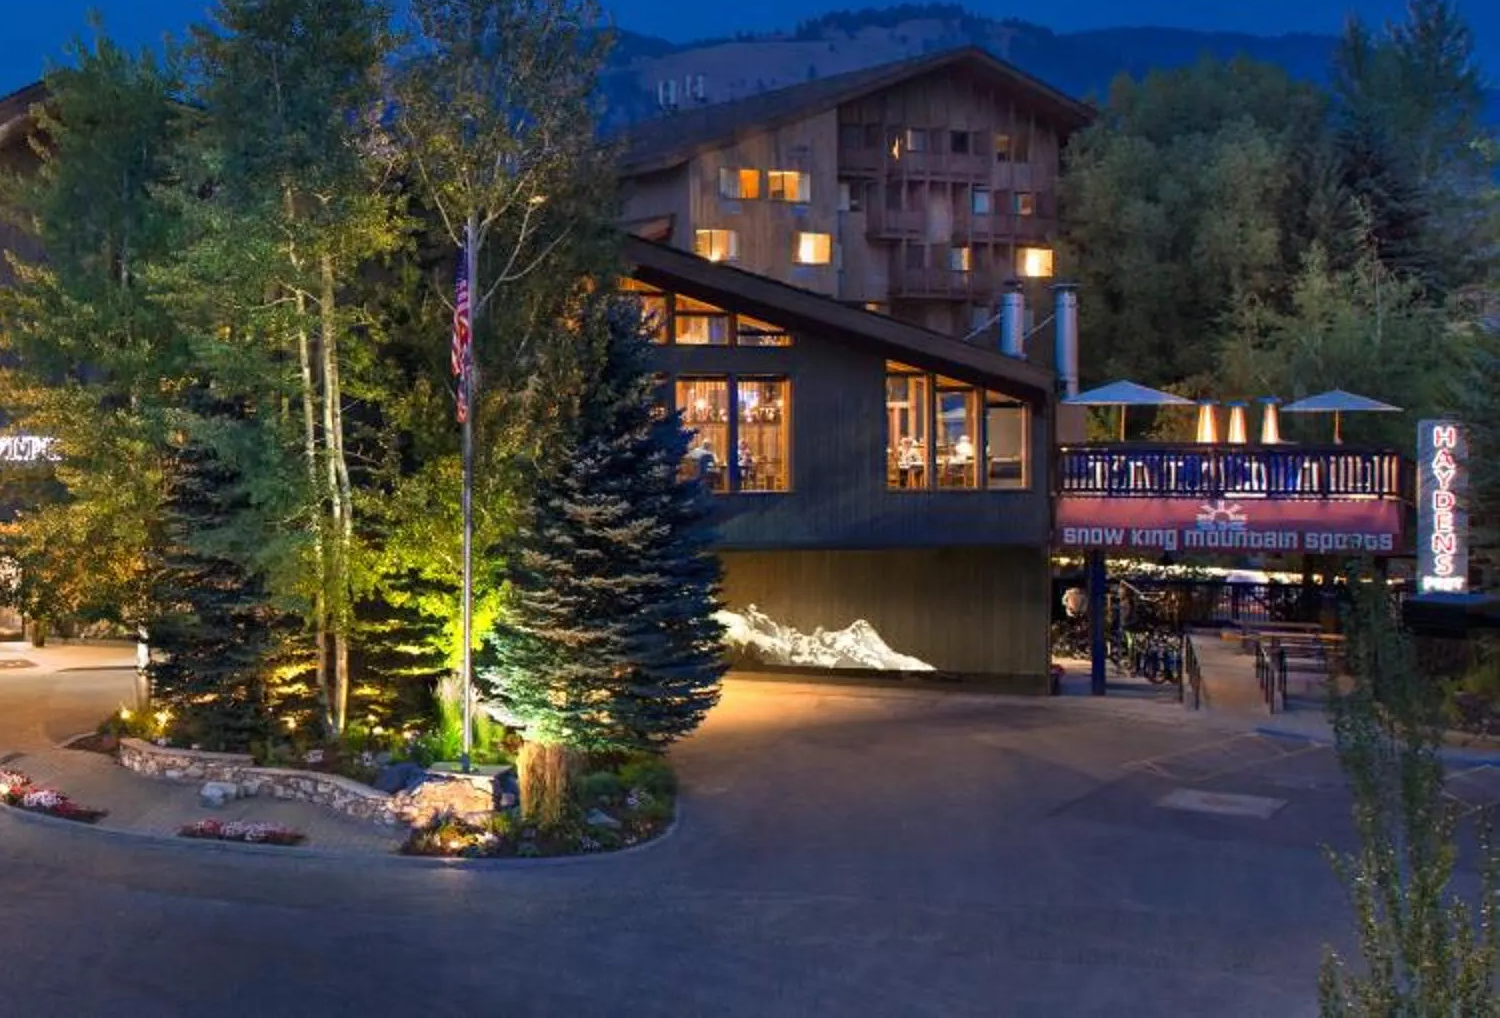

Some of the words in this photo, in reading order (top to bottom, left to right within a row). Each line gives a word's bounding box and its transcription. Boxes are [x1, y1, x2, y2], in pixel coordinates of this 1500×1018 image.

[1063, 527, 1125, 545] snow
[1130, 528, 1178, 551] king
[1184, 530, 1298, 549] mountain
[1431, 425, 1457, 576] HAYDENS
